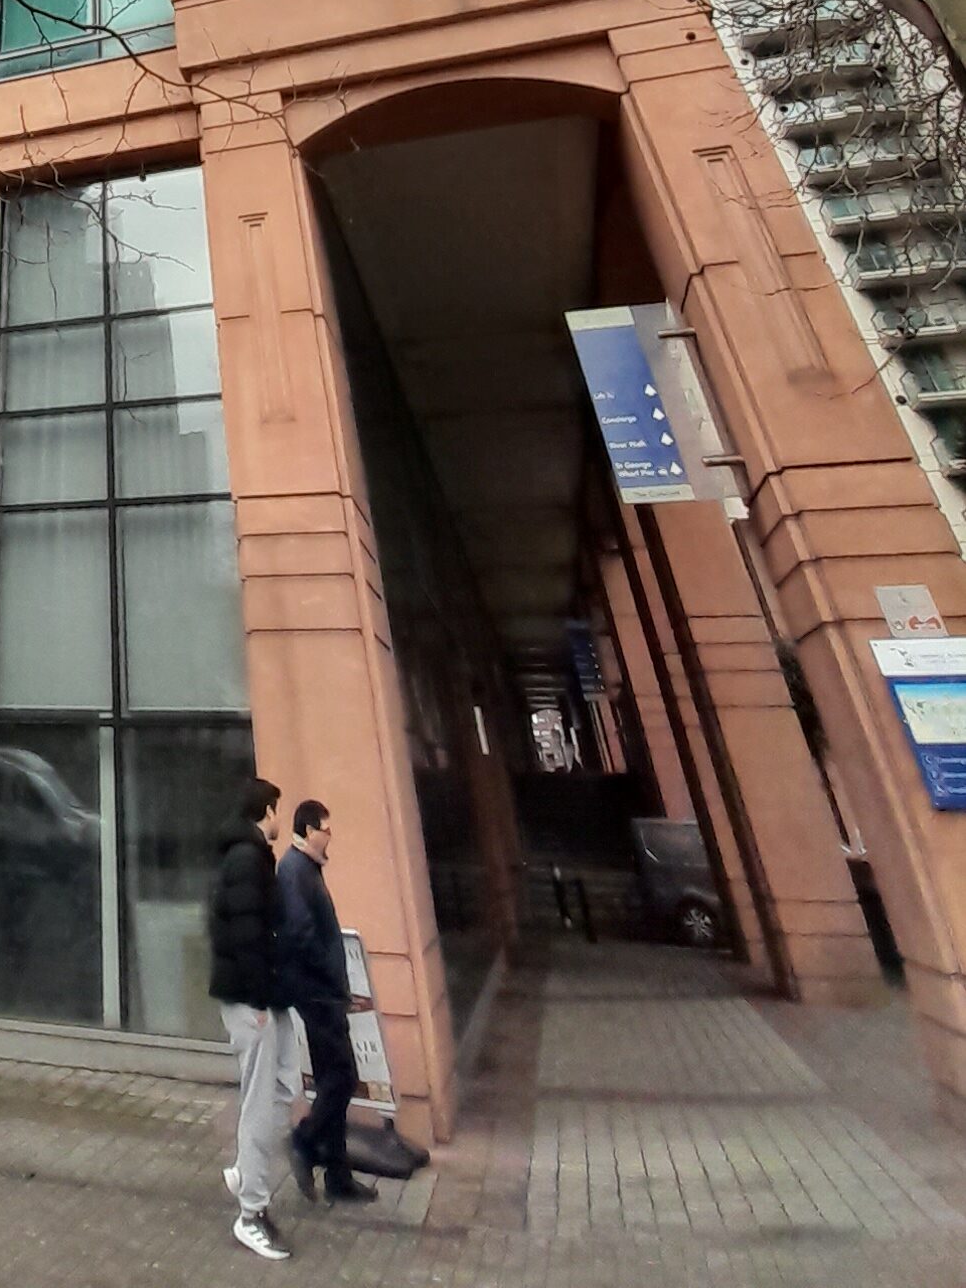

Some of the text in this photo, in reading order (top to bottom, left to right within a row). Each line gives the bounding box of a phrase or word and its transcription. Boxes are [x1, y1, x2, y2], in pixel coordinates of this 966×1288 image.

[601, 416, 637, 424] Concierge
[624, 462, 652, 470] George
[618, 469, 640, 478] Wharf
